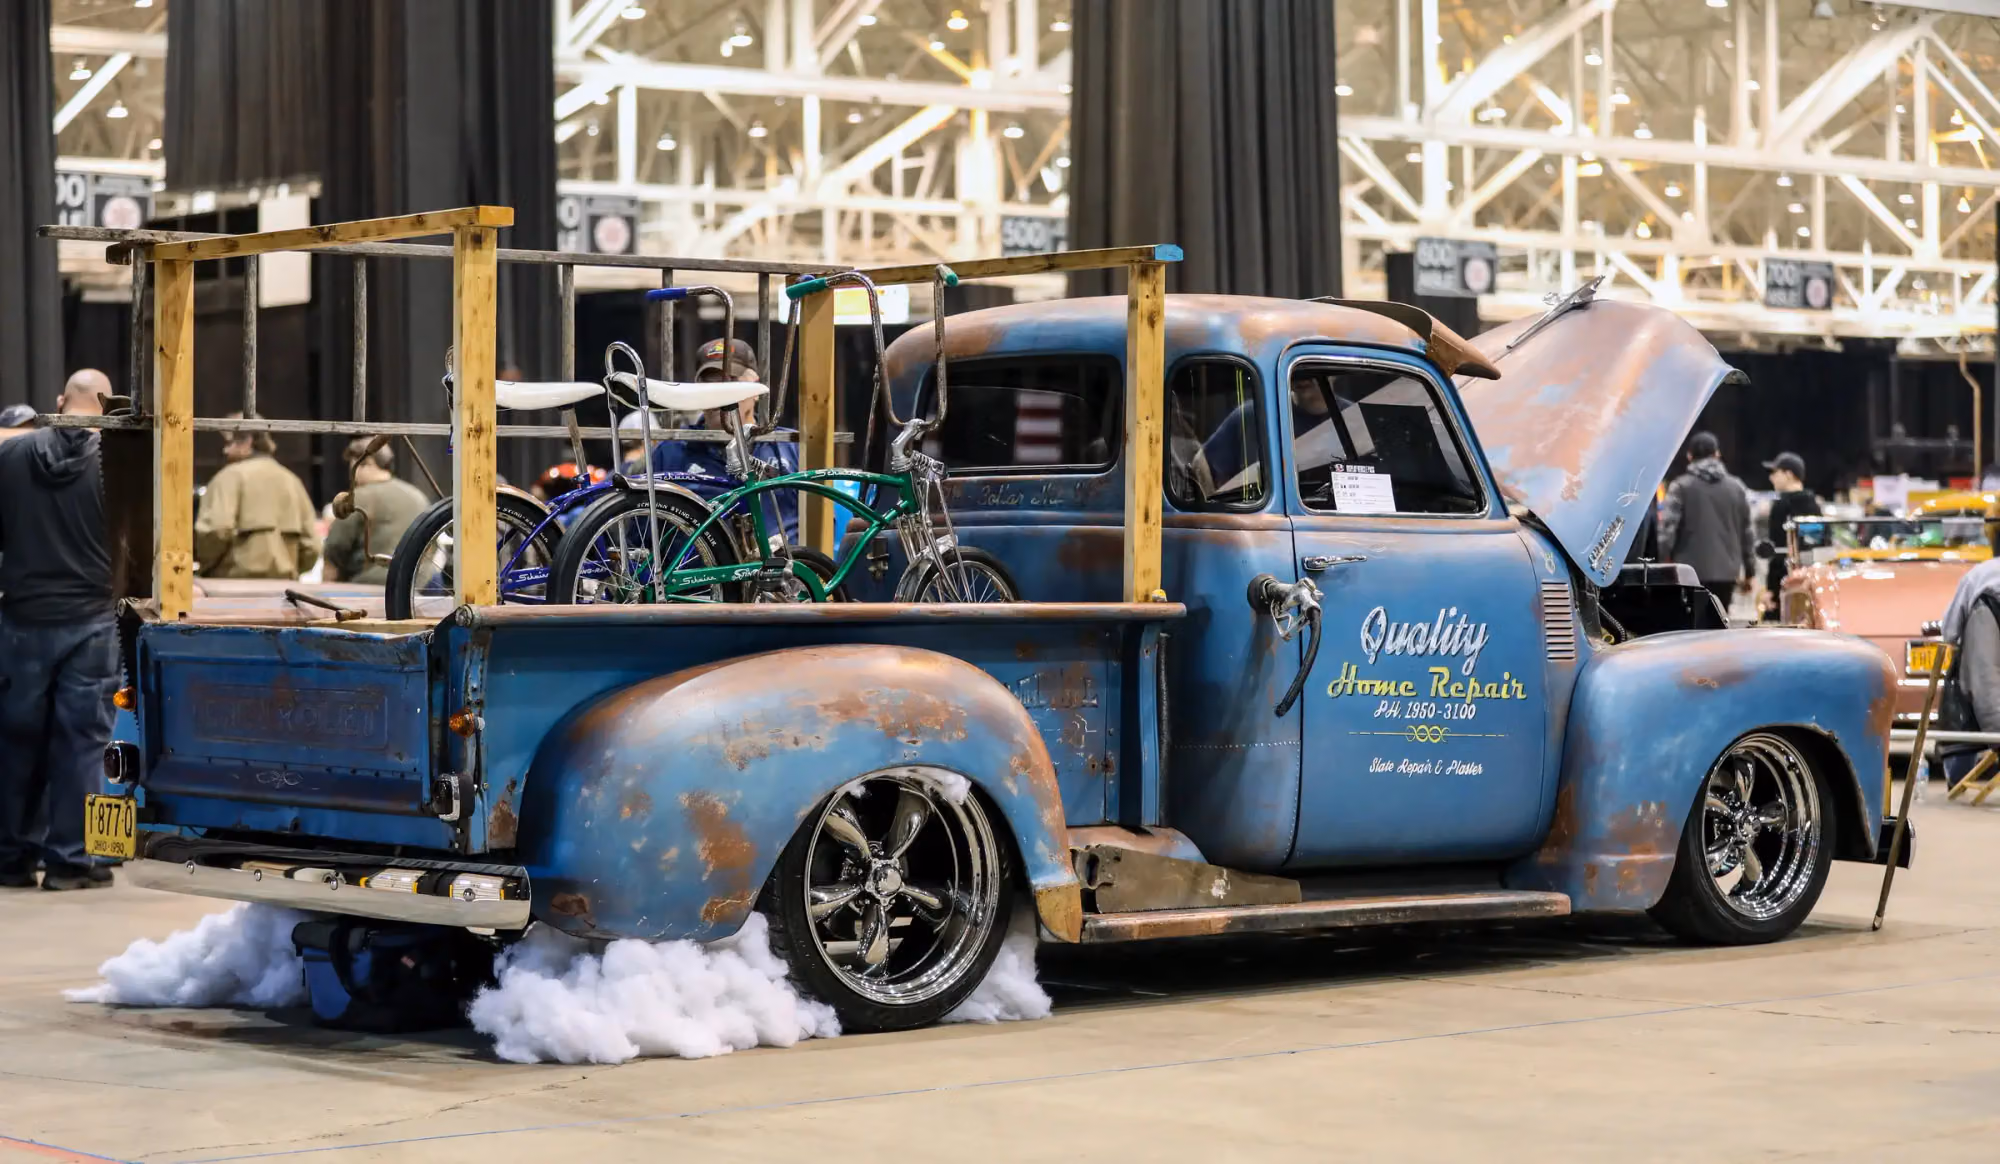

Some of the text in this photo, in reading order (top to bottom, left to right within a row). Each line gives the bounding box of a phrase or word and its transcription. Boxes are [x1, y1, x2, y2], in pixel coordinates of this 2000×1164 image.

[637, 502, 668, 510] SCHINN
[670, 506, 701, 527] STING-RA
[1360, 606, 1489, 676] Quality
[1327, 662, 1527, 704] Home Repair
[1374, 700, 1477, 720] PH. 1950-3100
[1369, 757, 1394, 773] Slate
[1397, 759, 1433, 778] Repair
[1446, 759, 1483, 776] Plaster
